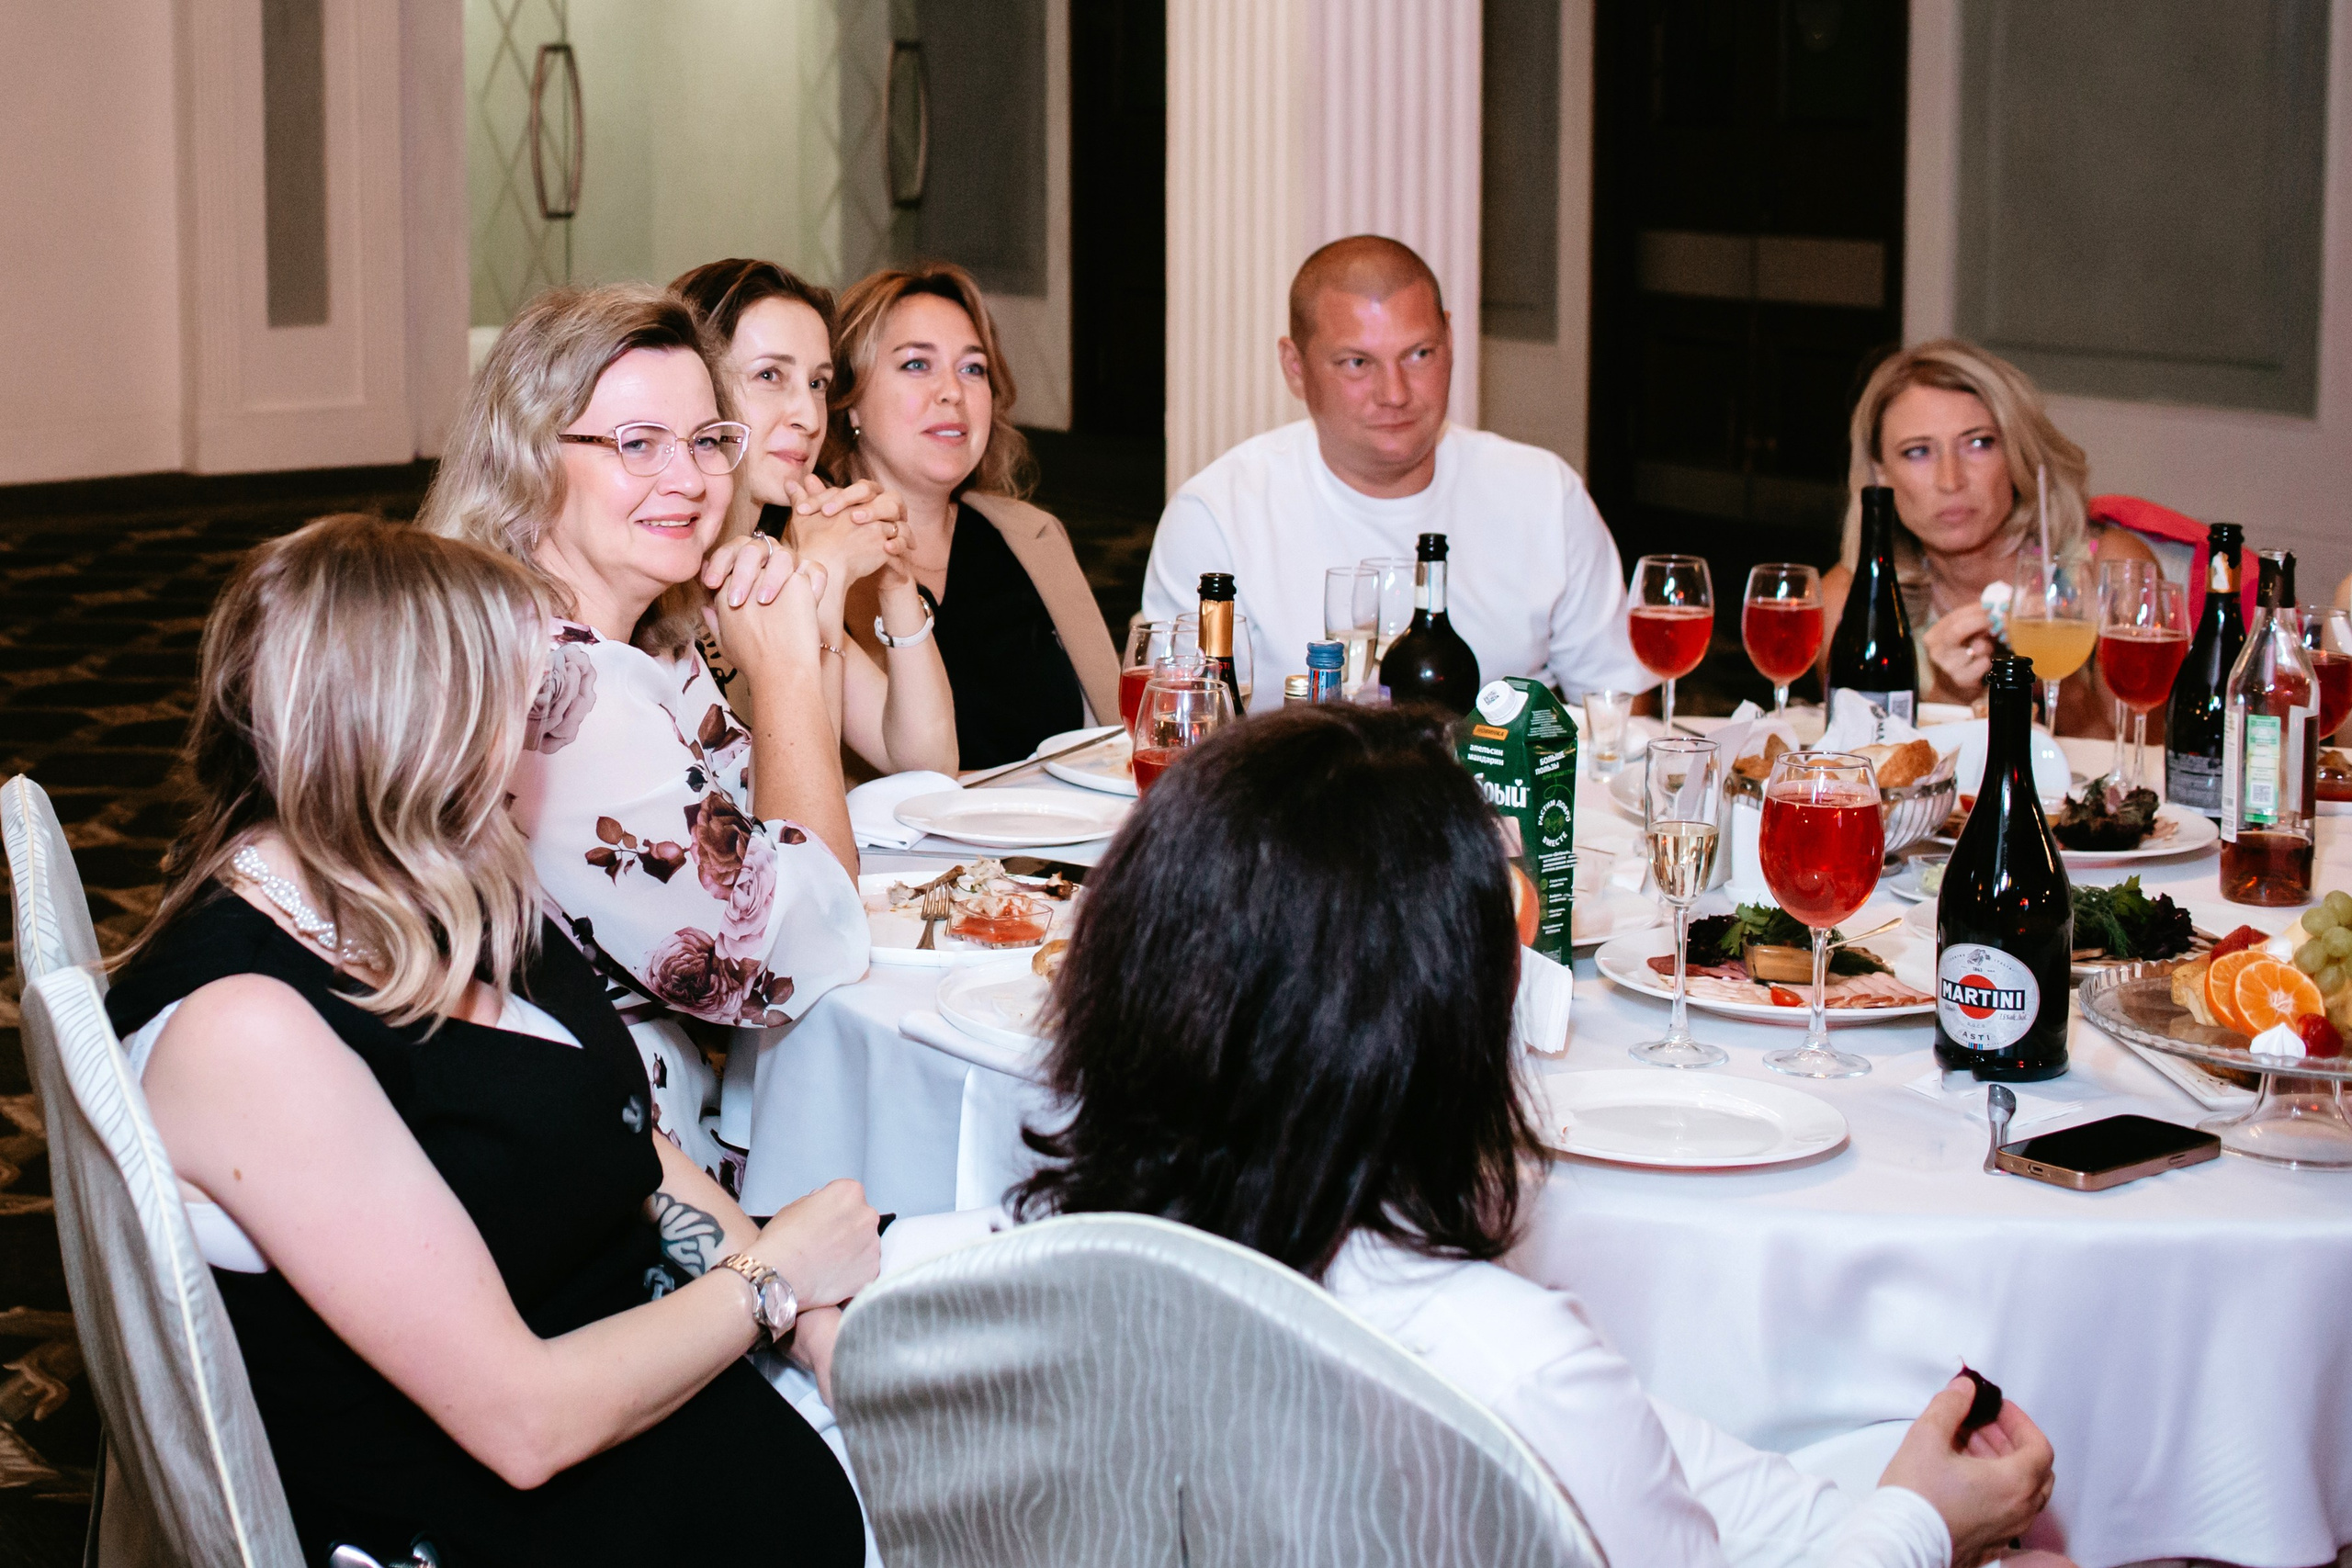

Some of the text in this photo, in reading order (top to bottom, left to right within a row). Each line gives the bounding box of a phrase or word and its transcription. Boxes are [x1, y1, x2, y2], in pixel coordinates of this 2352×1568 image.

[1469, 744, 1504, 756] апельсин
[1467, 753, 1504, 766] мандарин
[1539, 750, 1566, 766] БОЛЬШЕ
[1534, 761, 1560, 775] ПОЛЬЗЫ
[1538, 799, 1571, 826] РАСТИМ ДОБРО
[1542, 830, 1568, 847] ВМЕСТЕ
[1942, 980, 2022, 1009] MARTINI
[1962, 1031, 1990, 1041] ASTI
